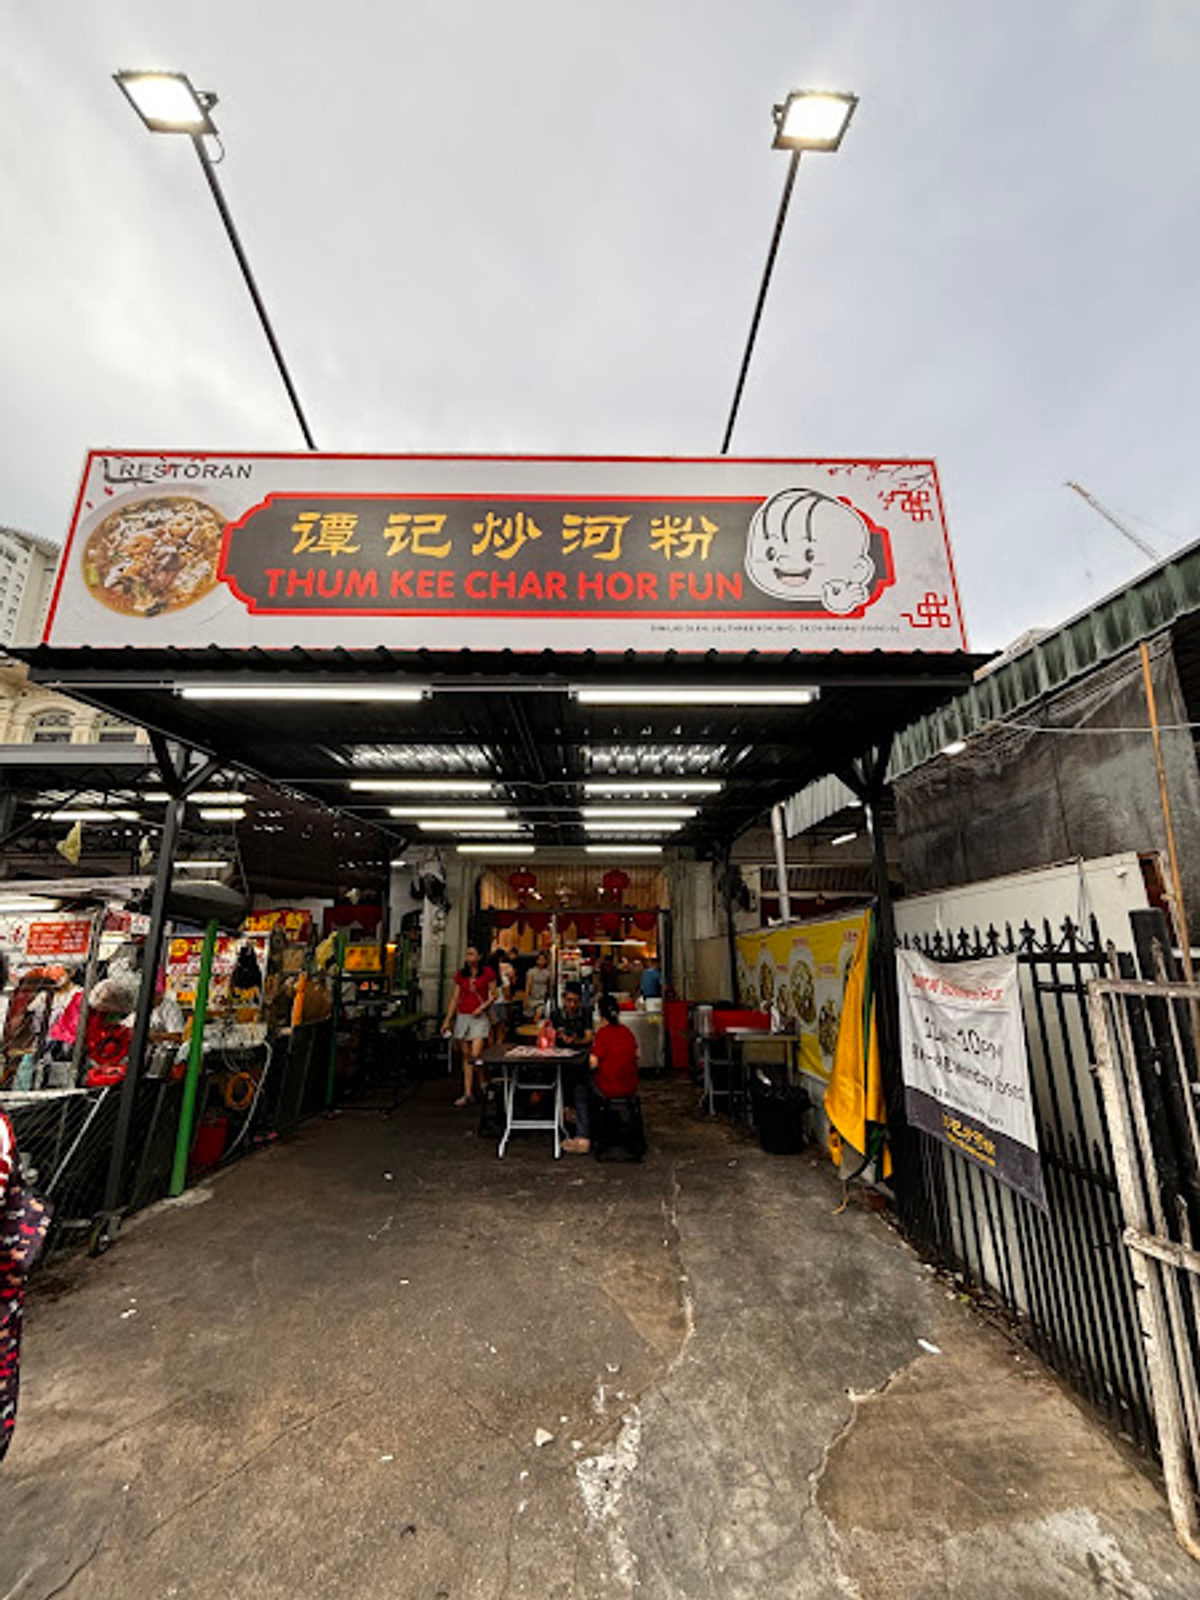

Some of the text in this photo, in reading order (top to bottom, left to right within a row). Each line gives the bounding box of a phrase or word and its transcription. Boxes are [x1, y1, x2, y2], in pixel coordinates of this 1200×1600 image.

[118, 462, 252, 480] RESTORAN
[291, 510, 720, 562] 谭记炒河粉
[264, 567, 743, 601] THUM KEE CHAR HOR FUN
